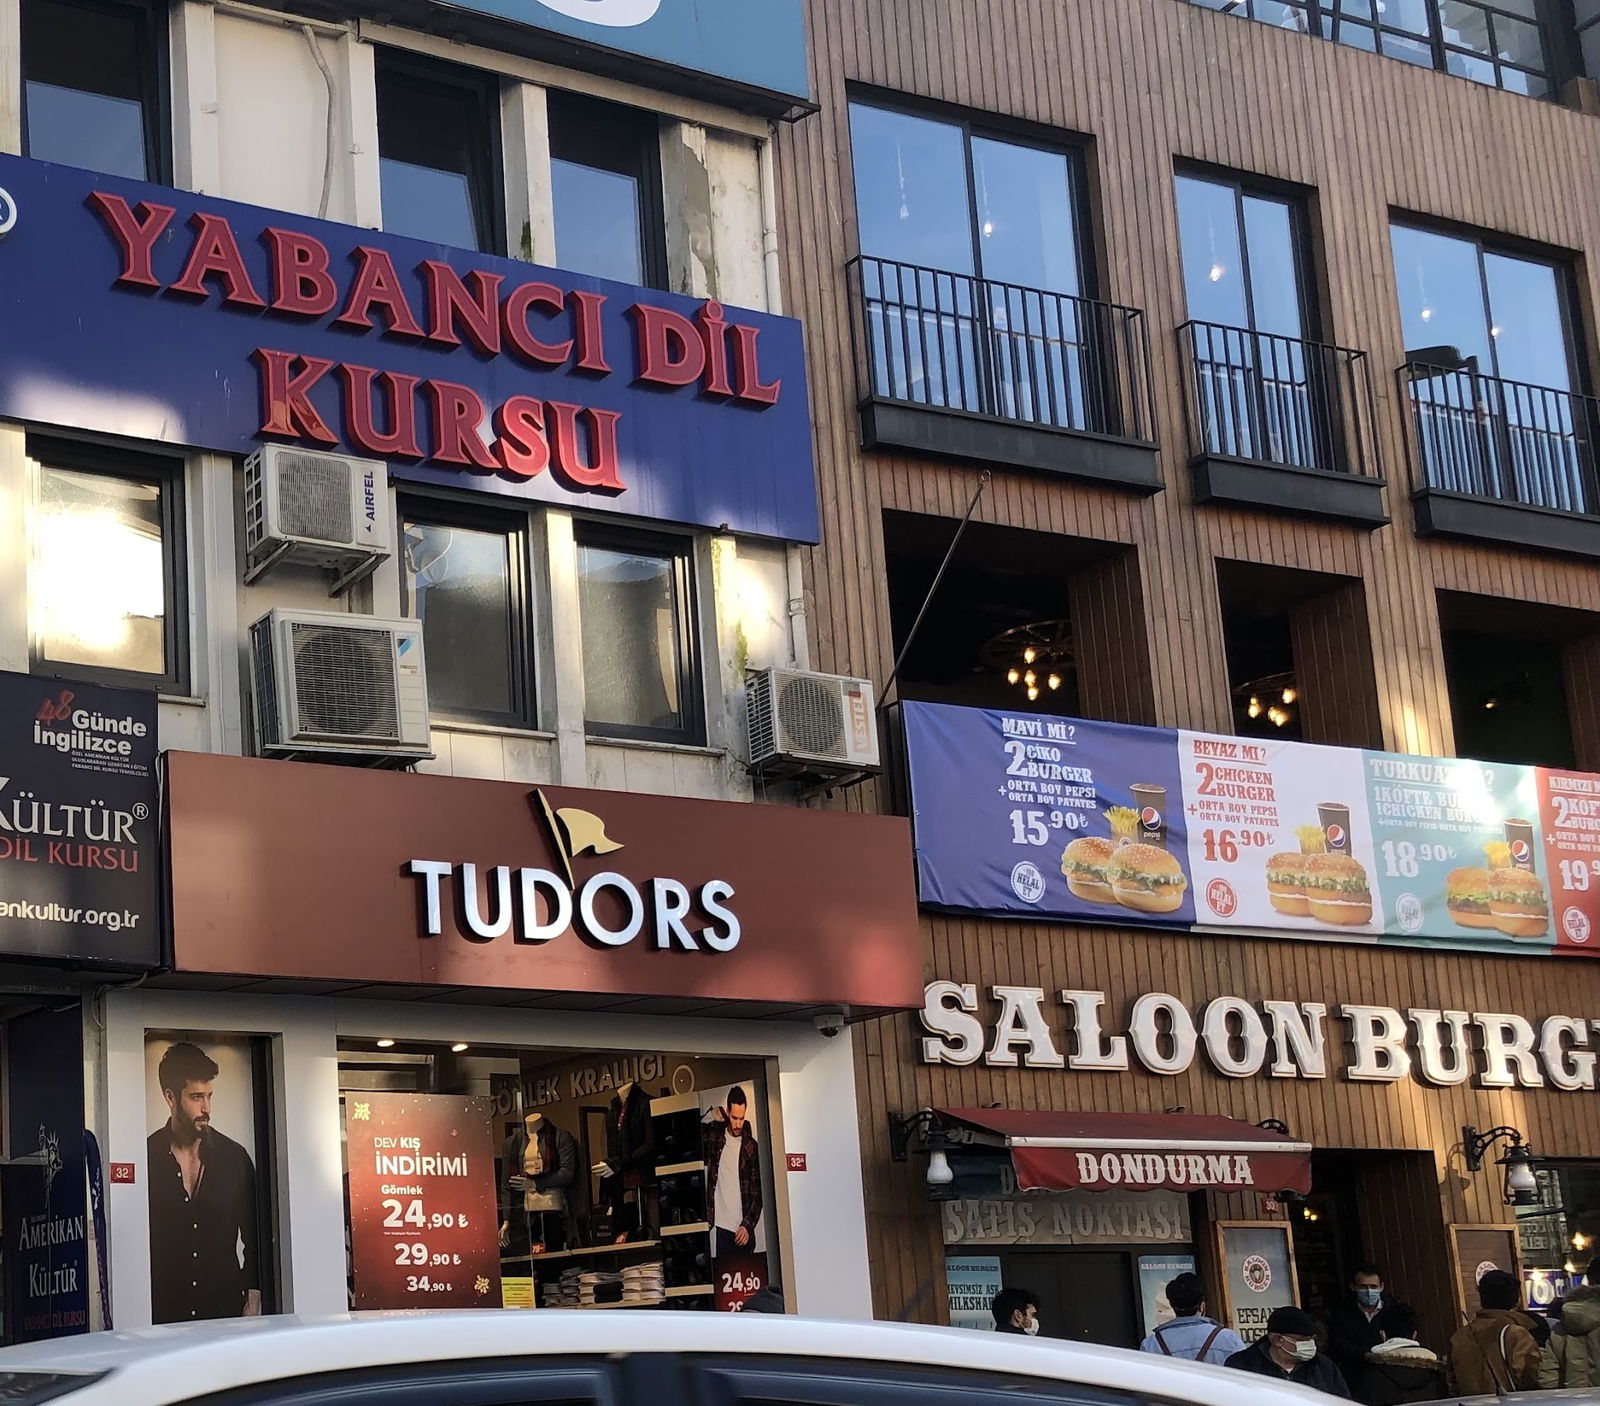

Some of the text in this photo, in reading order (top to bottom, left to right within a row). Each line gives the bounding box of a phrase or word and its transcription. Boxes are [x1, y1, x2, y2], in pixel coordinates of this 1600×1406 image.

[88, 190, 782, 406] YABANCI DİL
[250, 347, 628, 496] KURSU
[363, 471, 375, 521] AIRFEL
[36, 689, 148, 738] 48 Günde
[33, 719, 133, 756] İngilizce
[1001, 718, 1044, 737] MAVİ
[1004, 740, 1027, 776] 2
[1193, 739, 1238, 759] BEYAZ
[1026, 761, 1093, 784] BURGER
[1195, 762, 1274, 796] 2 CHICKEN
[1007, 779, 1038, 793] ORTA
[1040, 782, 1062, 796] BOY
[1008, 791, 1097, 810] ORTA BOY PATATES
[1216, 782, 1277, 803] BURGER
[1198, 799, 1226, 812] ORTA
[1228, 802, 1248, 814] BOY
[1199, 811, 1280, 828] ORTA BOY PATATES
[1551, 796, 1571, 828] 2
[48, 841, 140, 873] KURSU
[1016, 872, 1041, 891] HELAL
[1022, 886, 1033, 898] ET
[404, 858, 742, 953] TUDORS
[921, 979, 1600, 1092] SALOON BURG
[374, 1137, 421, 1152] DEV KIŞ
[116, 1168, 129, 1179] 32
[376, 1150, 469, 1177] İNDİRİMİ
[1075, 1152, 1254, 1185] DONDURMA
[381, 1184, 424, 1195] Gömlek
[381, 1199, 454, 1230] 24,90
[1052, 1202, 1185, 1240] NOKTASI
[19, 1214, 84, 1251] AMERİKAN
[394, 1243, 450, 1267] 29,90
[29, 1261, 78, 1298] KÜLTÜR
[406, 1275, 445, 1292] 34,90
[948, 1283, 982, 1295] EVSİMSİZ
